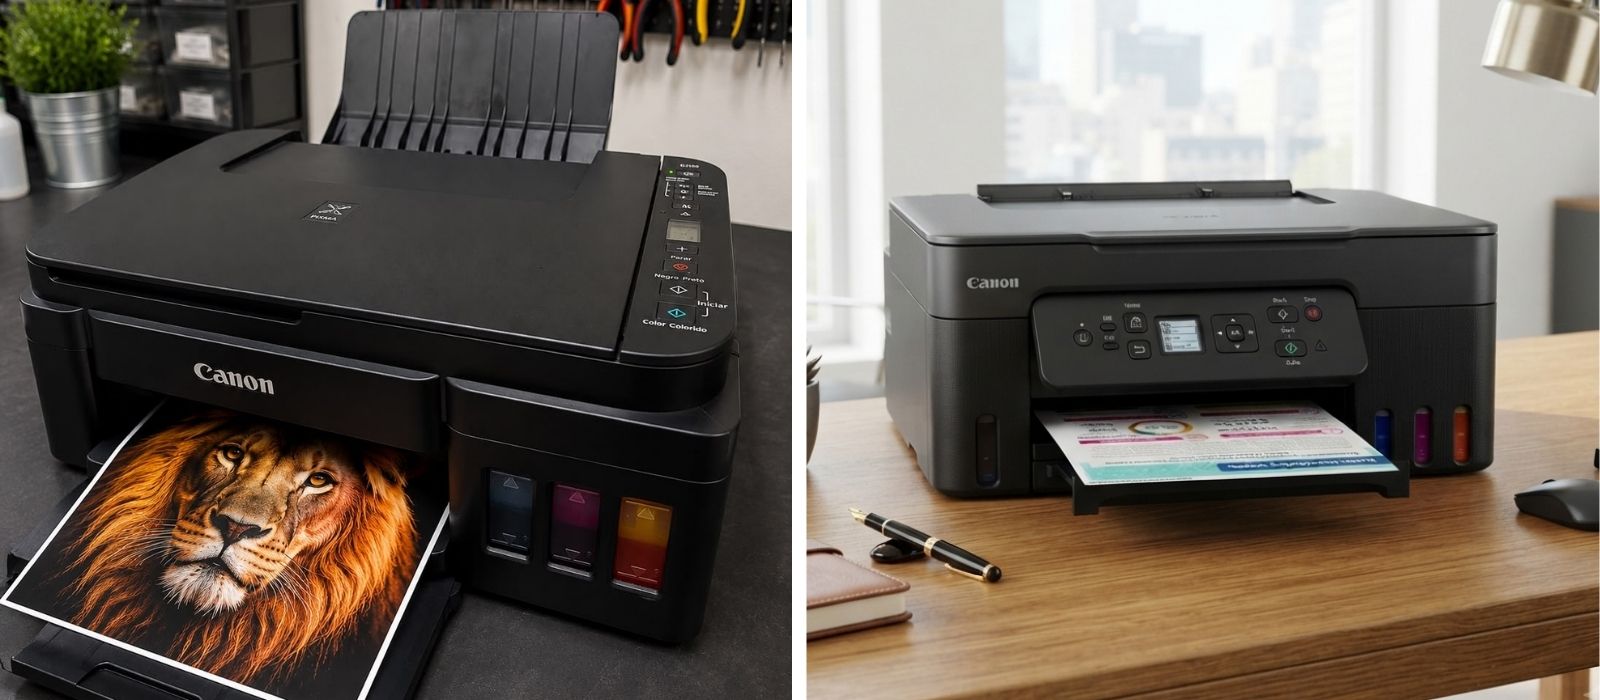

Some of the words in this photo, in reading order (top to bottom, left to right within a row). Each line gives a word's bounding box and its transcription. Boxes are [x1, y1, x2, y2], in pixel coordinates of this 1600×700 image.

[966, 276, 1019, 289] Canon
[697, 300, 729, 309] Iniciar
[642, 319, 667, 327] Color
[669, 323, 708, 333] Colorido
[193, 362, 275, 395] Canon
